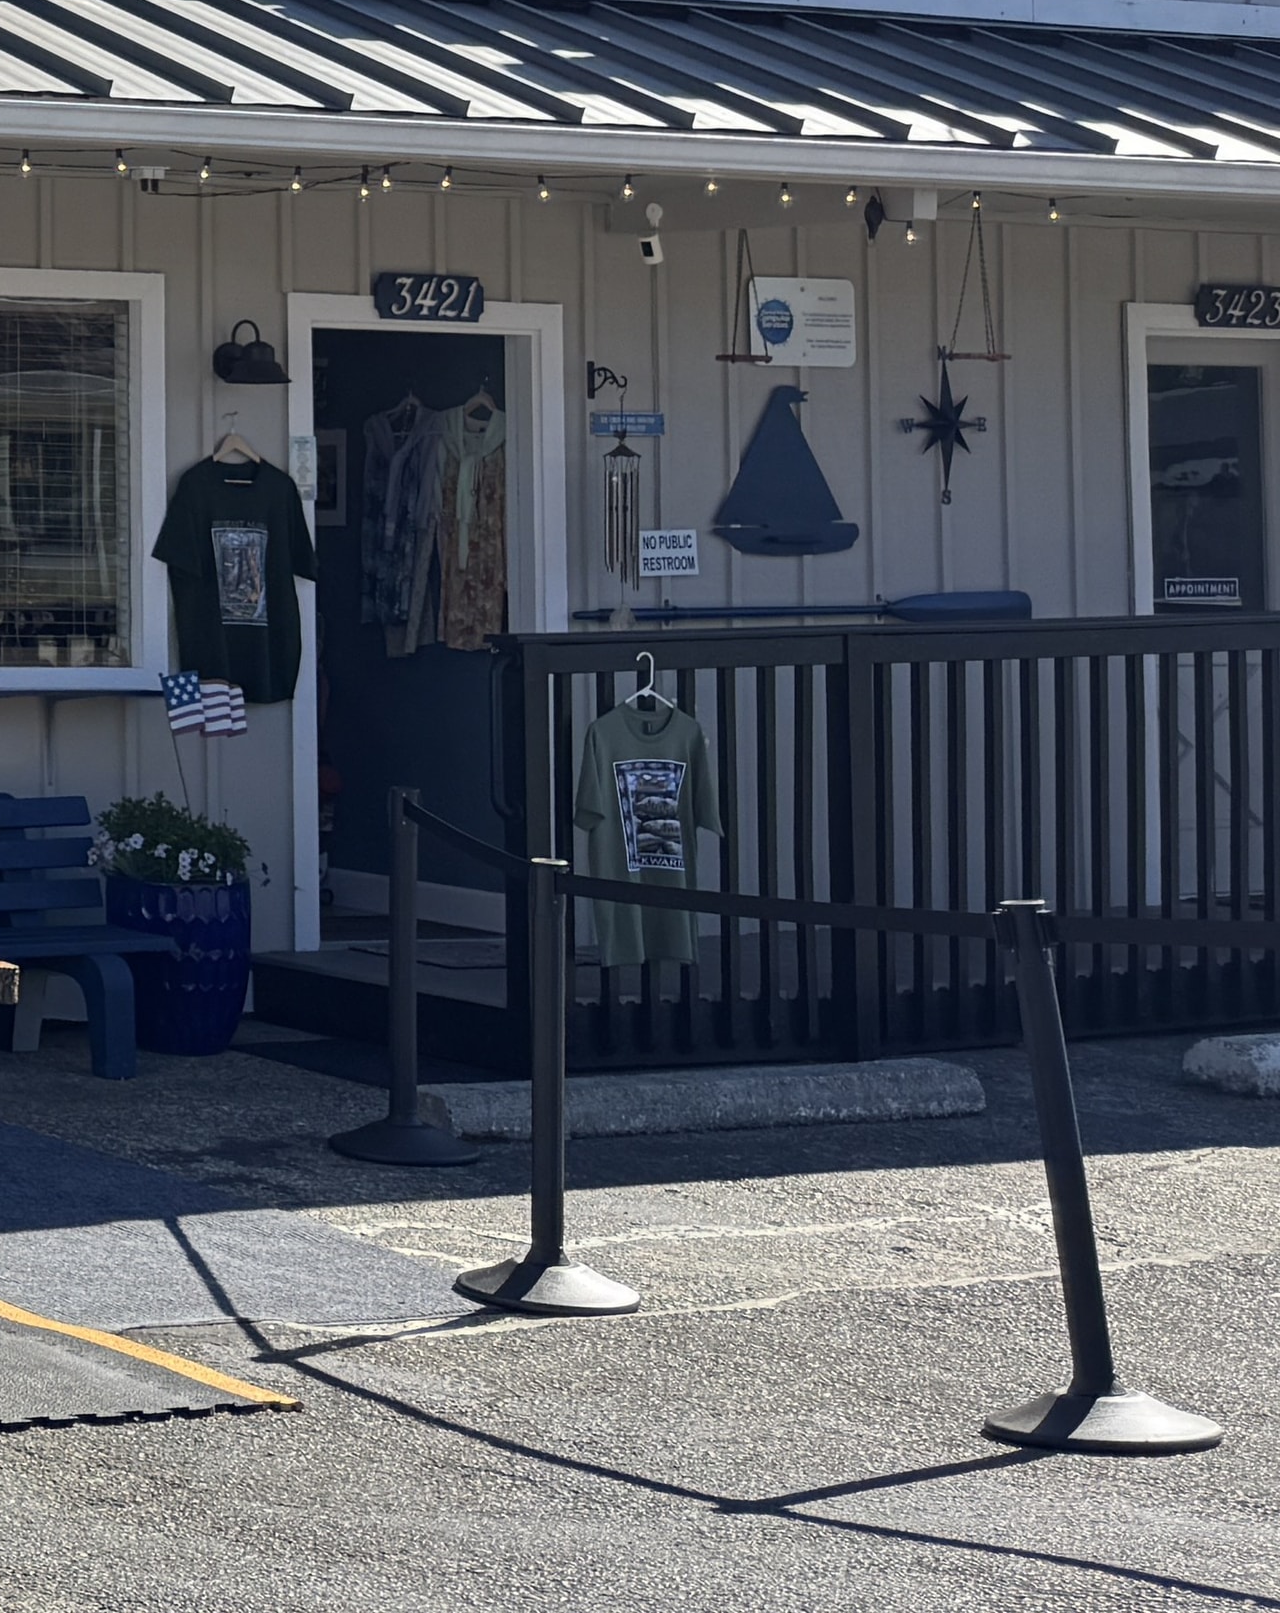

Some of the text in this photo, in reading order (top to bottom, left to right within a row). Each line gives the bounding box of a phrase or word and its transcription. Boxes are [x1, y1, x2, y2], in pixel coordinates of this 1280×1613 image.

[390, 276, 479, 318] 3421
[1205, 288, 1280, 327] 3423
[941, 490, 952, 505] S
[643, 534, 693, 550] NO PUBLIC
[643, 555, 696, 571] RESTROOM
[1169, 583, 1235, 595] APPOINTMENT
